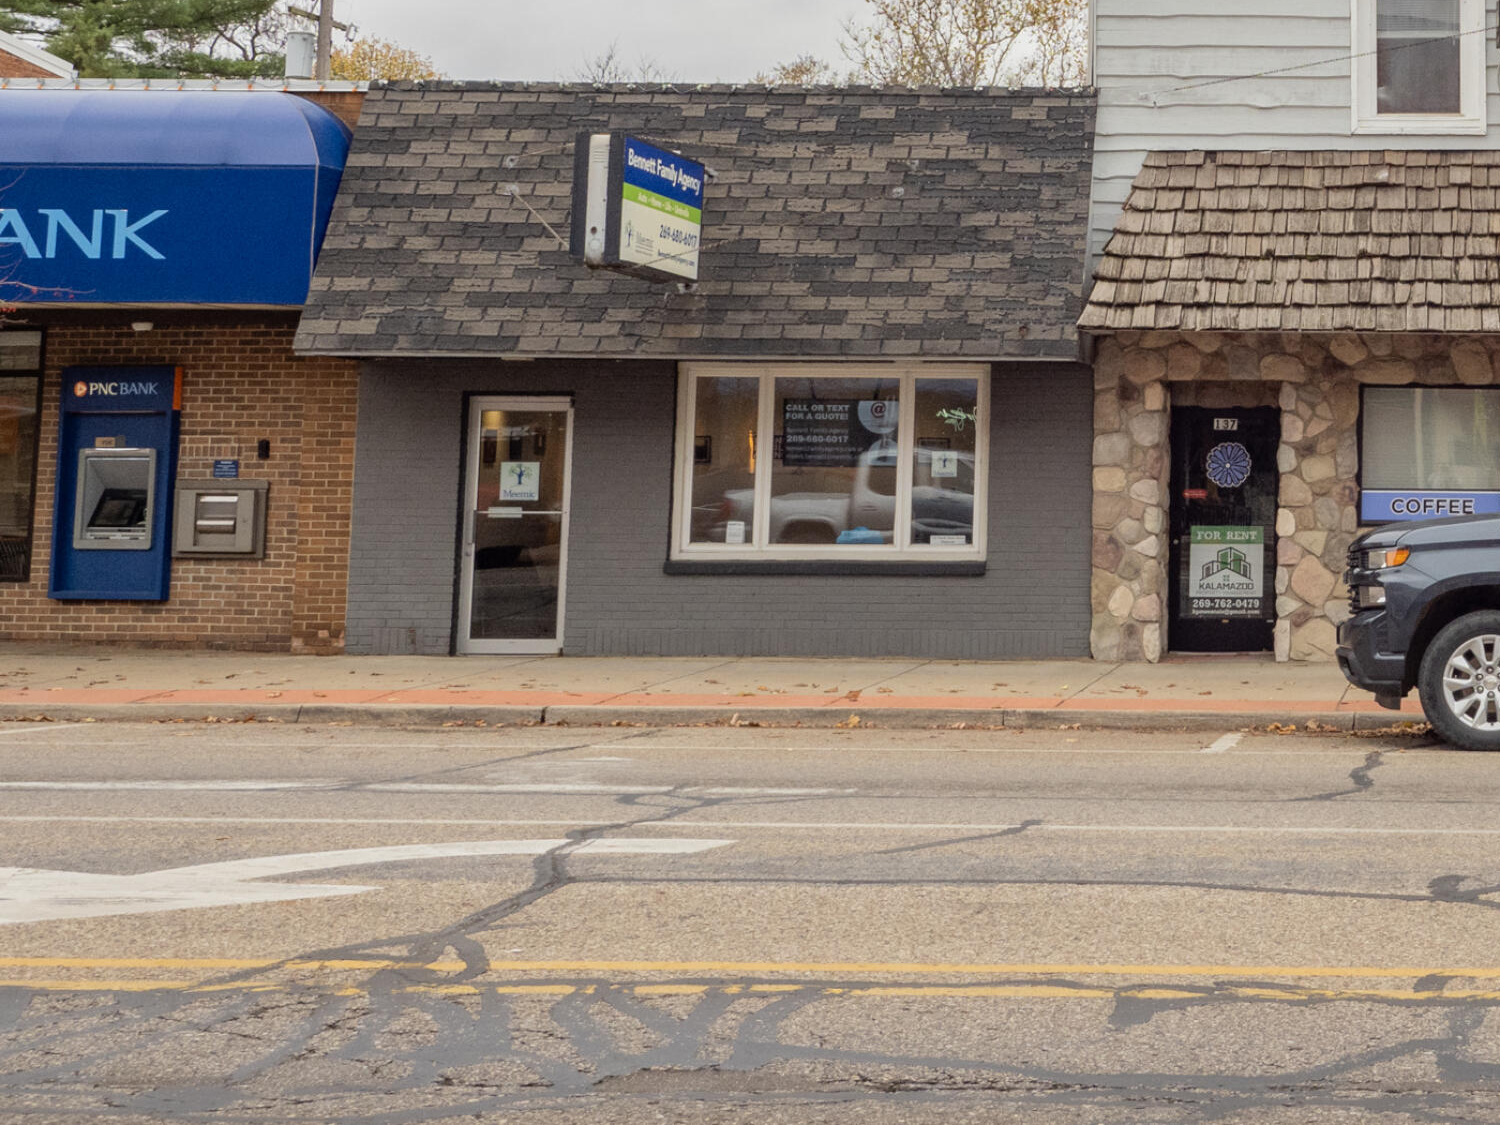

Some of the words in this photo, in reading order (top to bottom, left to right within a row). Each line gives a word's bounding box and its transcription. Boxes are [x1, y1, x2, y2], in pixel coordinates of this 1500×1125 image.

[628, 147, 656, 175] Bennett
[657, 159, 678, 187] Family
[678, 168, 701, 196] Agency
[0, 208, 169, 260] ANK
[786, 404, 809, 412] CALL
[811, 404, 824, 412] OR
[827, 404, 850, 412] TEXT
[1215, 419, 1237, 429] 137
[1391, 498, 1474, 515] COFFEE
[1197, 530, 1221, 540] FOR
[1226, 530, 1257, 540] RENT
[1199, 582, 1254, 590] KALAMAZOO
[1192, 598, 1260, 608] 269-762-0479
